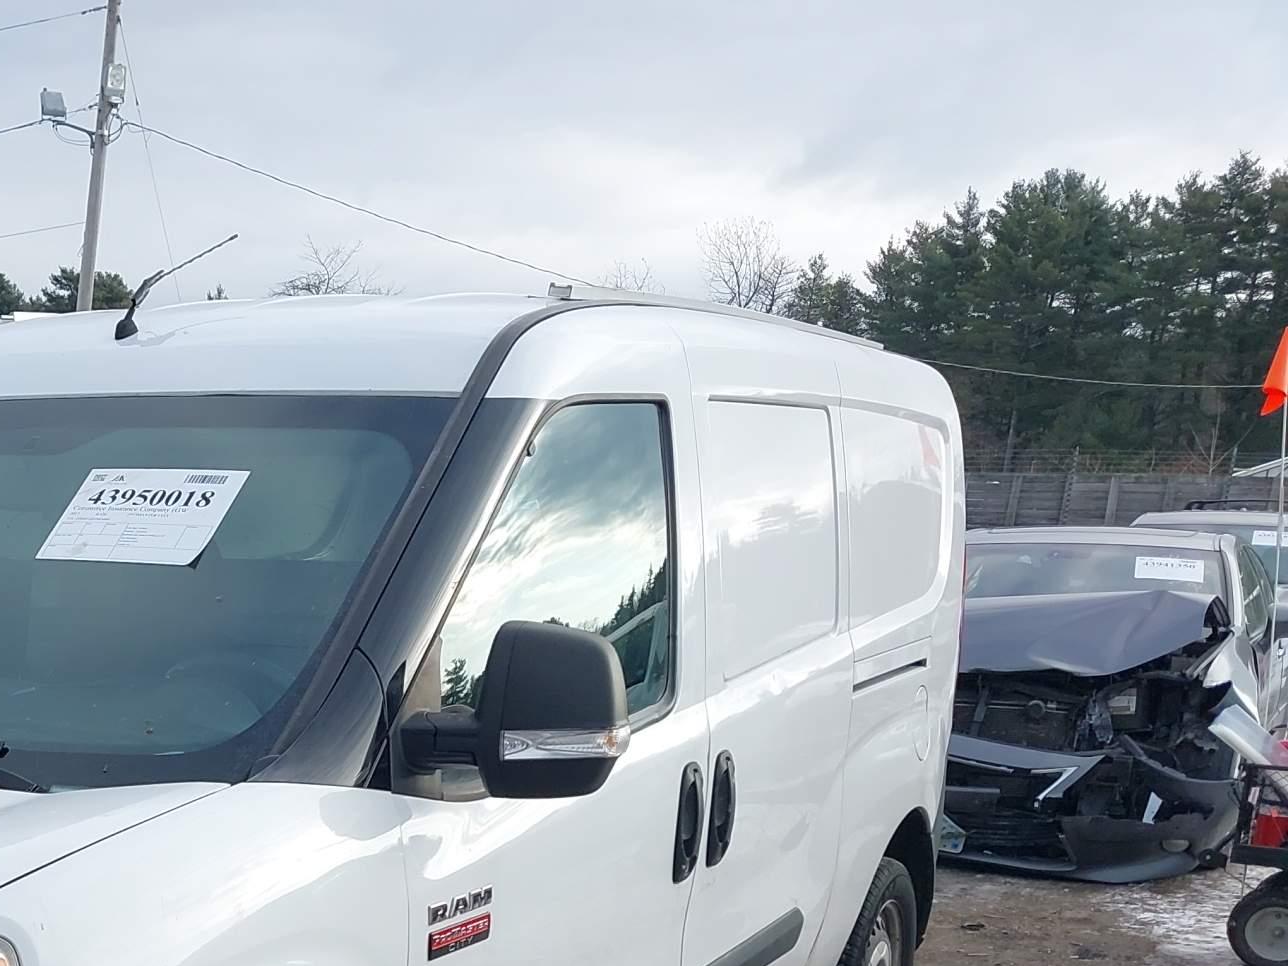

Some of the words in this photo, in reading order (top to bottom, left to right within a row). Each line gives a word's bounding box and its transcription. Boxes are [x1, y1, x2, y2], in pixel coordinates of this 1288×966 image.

[87, 488, 216, 508] 43950018
[428, 885, 493, 926] RAM
[448, 936, 473, 952] CITY
